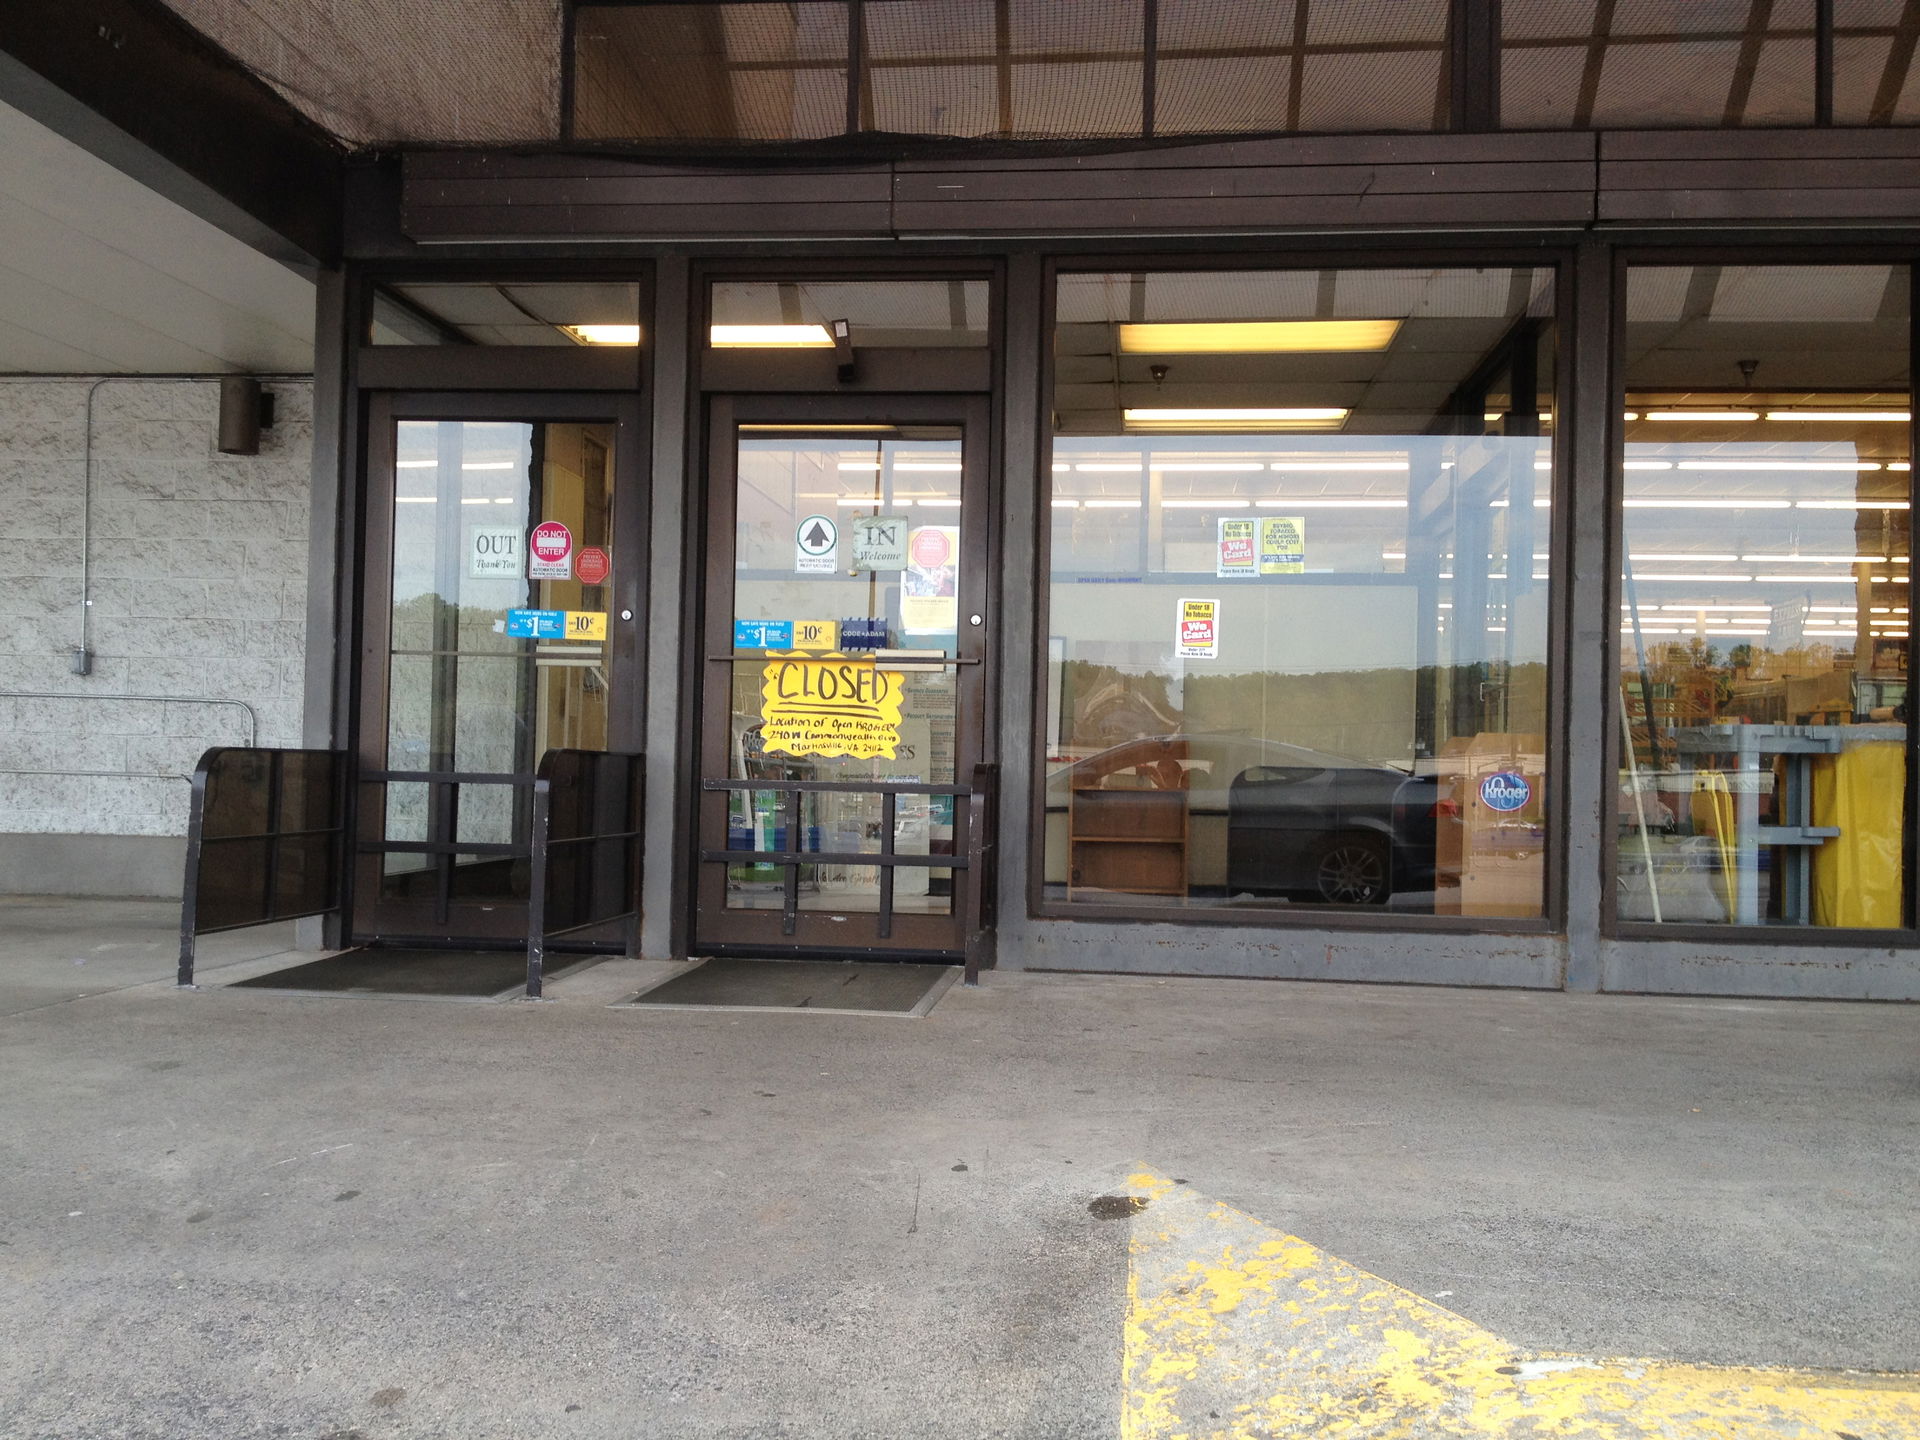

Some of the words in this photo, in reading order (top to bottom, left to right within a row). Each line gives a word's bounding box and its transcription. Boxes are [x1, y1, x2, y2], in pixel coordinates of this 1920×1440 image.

[537, 530, 549, 538] DO
[550, 530, 567, 538] NOT
[864, 526, 896, 546] IN
[476, 534, 517, 554] OUT
[1228, 541, 1248, 551] We
[538, 547, 565, 556] ENTER
[860, 551, 901, 560] Welcome
[1223, 550, 1251, 559] Card
[477, 559, 500, 569] Thank
[502, 559, 516, 569] You
[526, 616, 540, 637] $1
[576, 616, 594, 631] 10¢
[1187, 622, 1208, 631] We
[753, 626, 768, 647] $1
[803, 625, 823, 641] 10¢
[1183, 630, 1212, 639] Card
[770, 716, 811, 727] Location
[813, 717, 828, 728] of
[832, 719, 853, 732] Open
[770, 730, 790, 740] 240
[805, 730, 876, 741] Commonwealth
[847, 744, 859, 752] VA
[863, 743, 884, 752] 24112
[1484, 776, 1528, 809] Kroger
